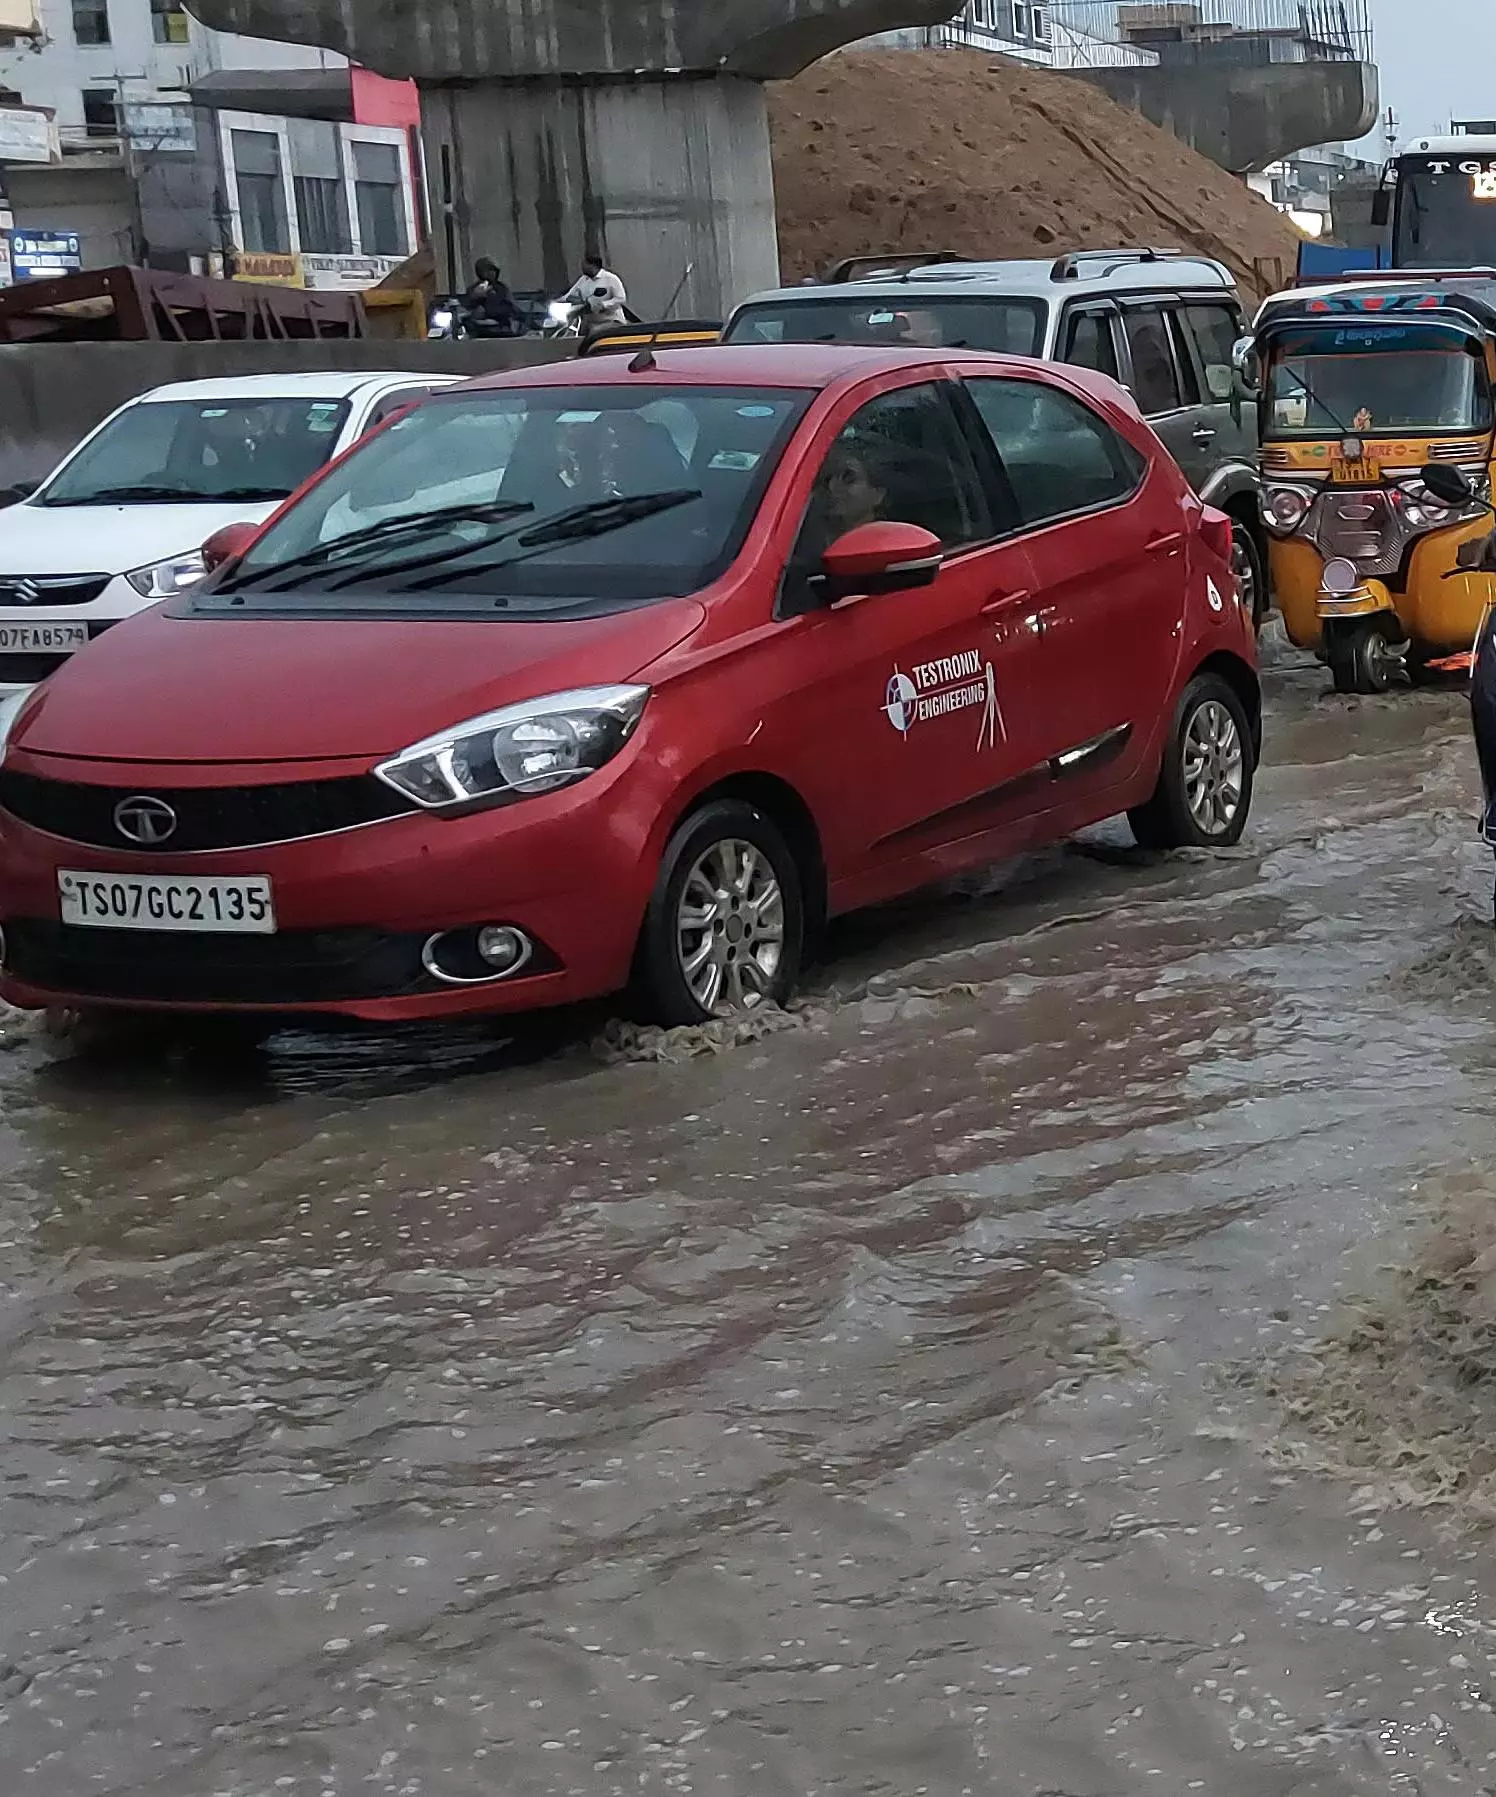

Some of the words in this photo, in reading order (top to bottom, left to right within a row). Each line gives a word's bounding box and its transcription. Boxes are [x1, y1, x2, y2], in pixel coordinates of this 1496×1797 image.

[912, 649, 982, 689] TESTRONIX
[919, 683, 985, 721] ENGINEERING
[76, 881, 266, 921] TS07GC2135
